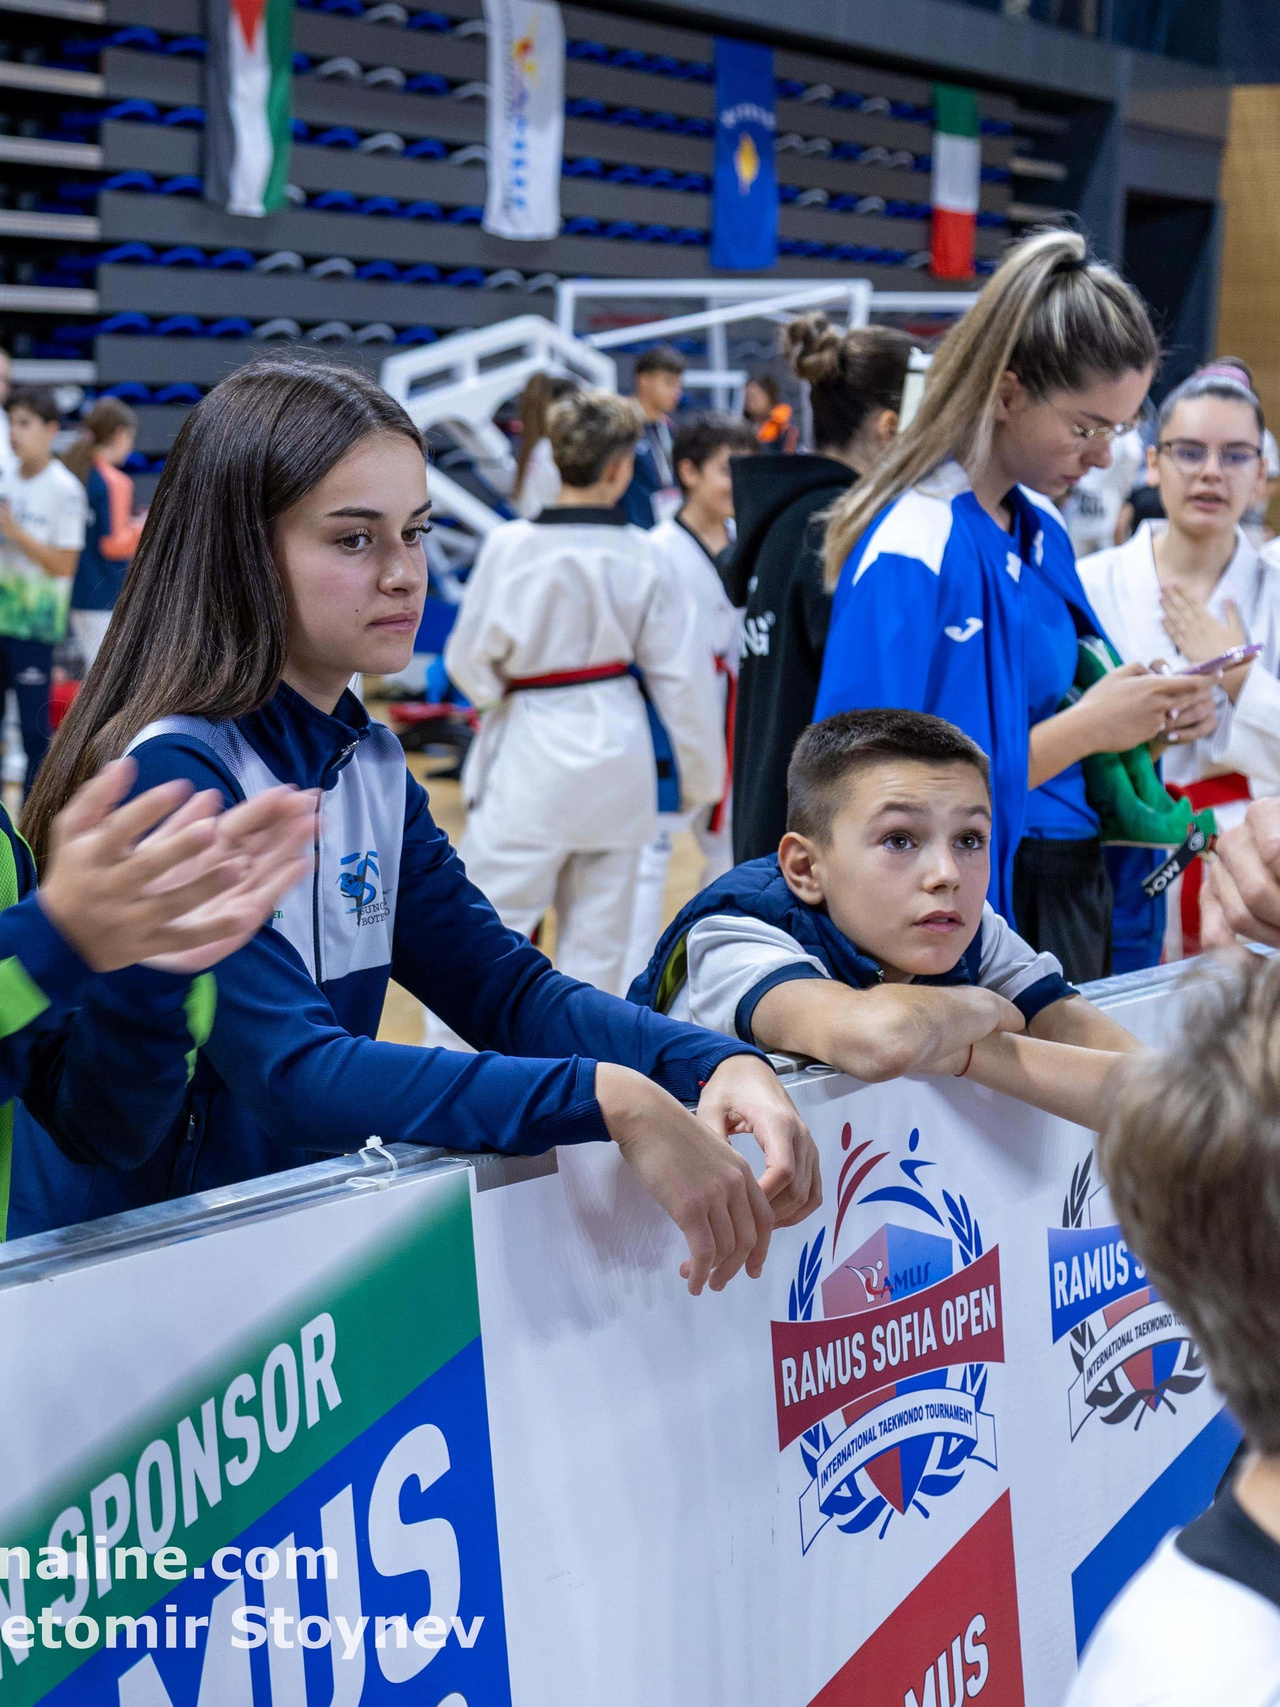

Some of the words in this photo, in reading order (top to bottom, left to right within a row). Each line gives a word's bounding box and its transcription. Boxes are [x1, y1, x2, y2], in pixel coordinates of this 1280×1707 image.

[1053, 1240, 1130, 1310] RAMUS
[781, 1331, 867, 1408] RAMUS
[871, 1306, 938, 1373] SOFIA
[940, 1284, 997, 1346] OPEN
[1086, 1330, 1134, 1384] INTERNATIONAL
[1134, 1313, 1172, 1340] TAEKWONDO
[47, 1312, 343, 1629] SPONSOR
[820, 1428, 878, 1490] INTERNATIONAL
[878, 1404, 924, 1436] TAEKWONDO
[924, 1402, 974, 1426] TOURNAMENT
